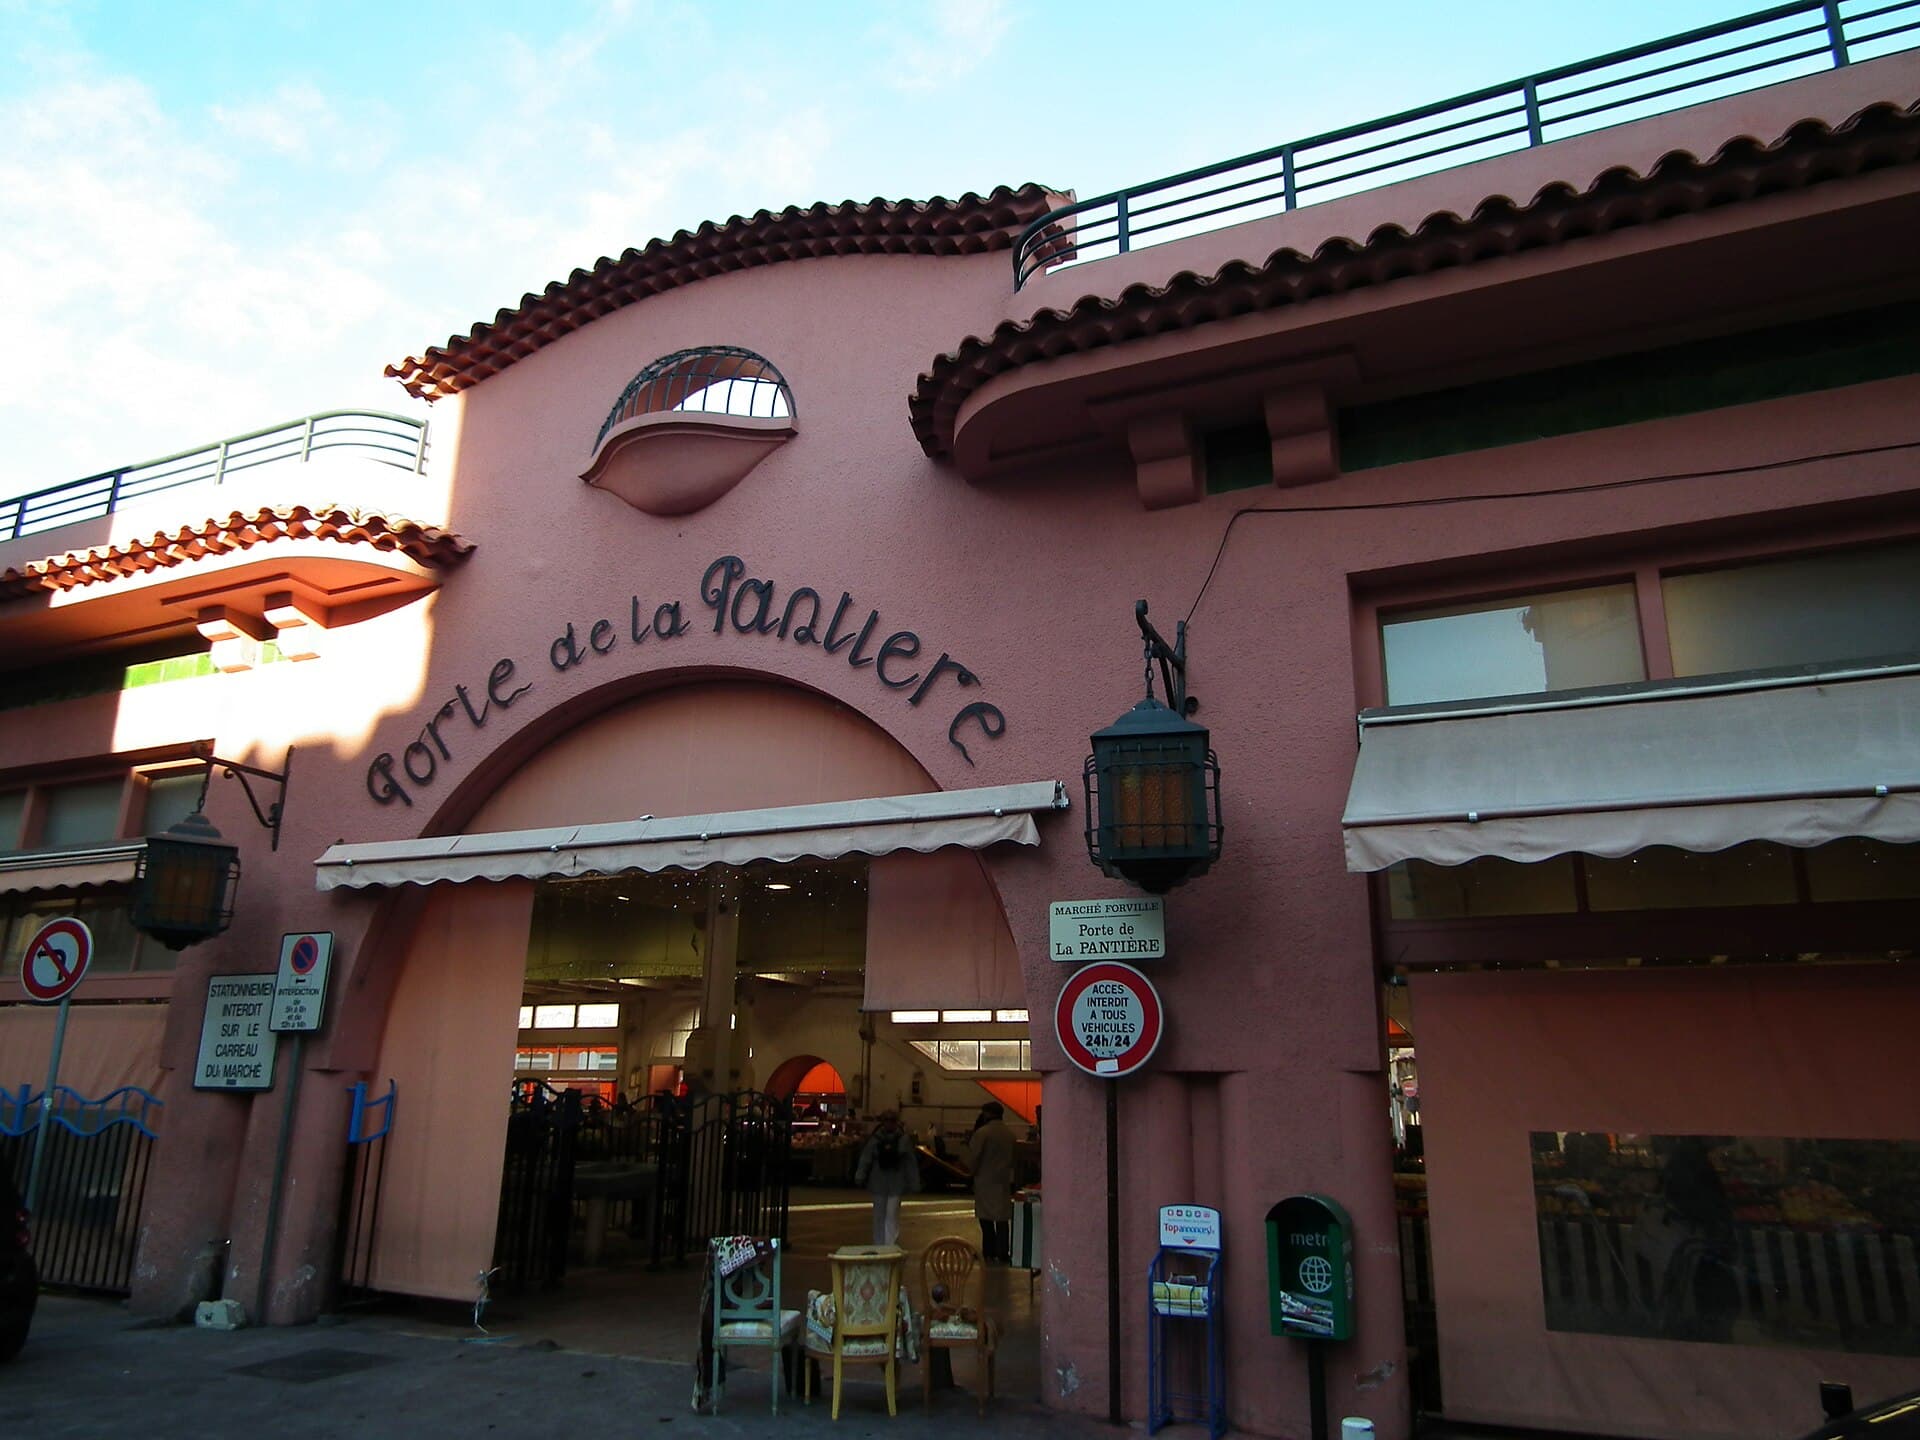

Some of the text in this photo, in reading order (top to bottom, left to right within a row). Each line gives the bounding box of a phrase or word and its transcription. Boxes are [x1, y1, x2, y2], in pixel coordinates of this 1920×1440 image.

[366, 658, 534, 808] Porte
[550, 622, 617, 672] de
[632, 595, 691, 644] la
[1055, 902, 1160, 916] MARCHÉ FORVILLE
[1079, 922, 1135, 937] Porte de
[1056, 937, 1160, 956] La PANTIÈRE
[210, 983, 275, 997] STATIONNEMEN
[1092, 984, 1125, 995] ACCES
[1087, 997, 1129, 1008] INTERDIT
[222, 1003, 263, 1017] INTERDIT
[1090, 1010, 1127, 1021] A TOUS
[221, 1023, 259, 1037] SUR LE
[1081, 1022, 1136, 1034] VEHICULES
[1085, 1034, 1131, 1048] 24h/24
[215, 1044, 258, 1058] CARREAU
[205, 1062, 263, 1078] DU MARCHÉ
[1290, 1231, 1329, 1247] metr
